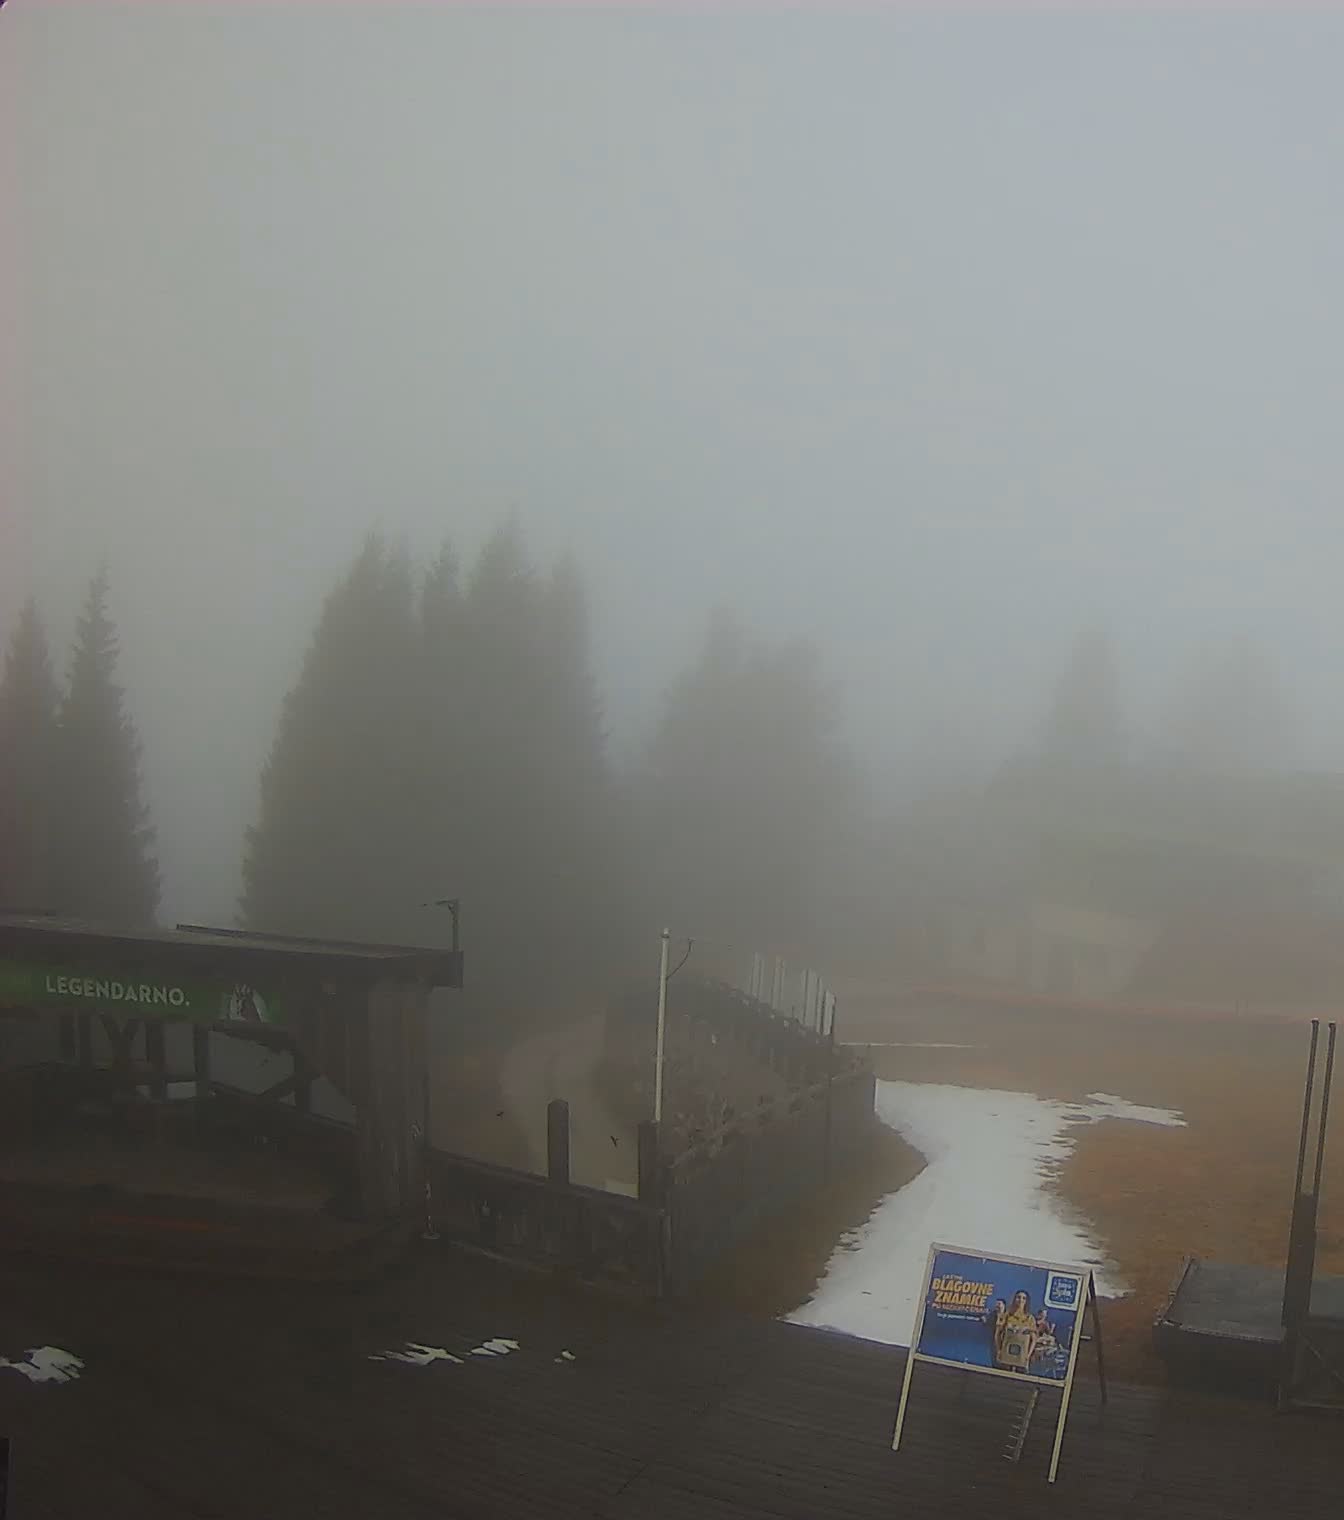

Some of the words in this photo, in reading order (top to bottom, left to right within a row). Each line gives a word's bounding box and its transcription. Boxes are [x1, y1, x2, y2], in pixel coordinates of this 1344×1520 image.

[45, 975, 190, 1006] LEGENDARNO.
[931, 1278, 994, 1296] BLAGOVNE
[934, 1291, 988, 1308] ZNAMKE
